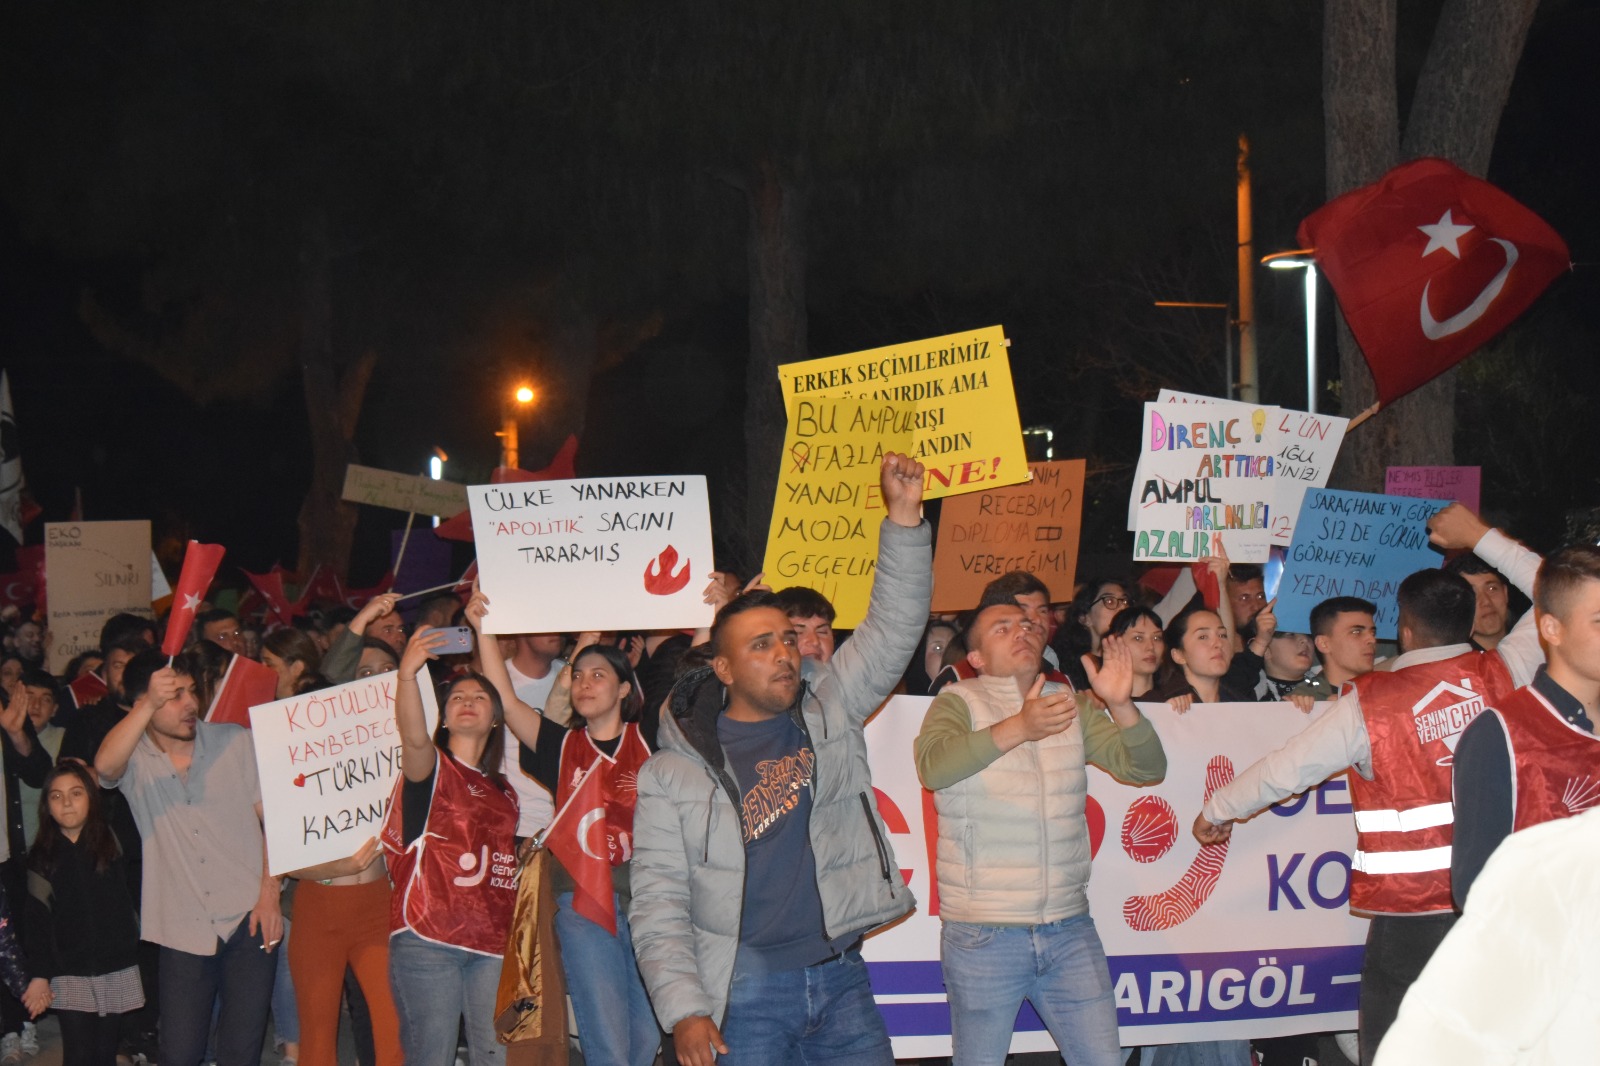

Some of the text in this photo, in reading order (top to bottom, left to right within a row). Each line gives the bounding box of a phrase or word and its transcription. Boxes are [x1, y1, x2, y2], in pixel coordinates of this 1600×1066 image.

[793, 338, 991, 394] ERKEK SEÇİMLERİMİZ
[948, 370, 990, 395] AMA
[796, 401, 914, 438] BU AMPUL
[812, 441, 884, 472] FAZLA
[1196, 454, 1274, 480] ARTTIKÇA
[484, 480, 686, 512] ÜLKE YANARKEN
[785, 481, 860, 507] YANDI
[1140, 478, 1222, 504] AMPUL
[777, 515, 866, 542] MODA
[1185, 501, 1270, 530] PARLAKLIĞI
[1317, 516, 1346, 541] SİZ
[1350, 522, 1373, 542] DE
[517, 542, 621, 566] TARARMIŞ
[284, 681, 396, 733] KÖTÜLÜK
[1414, 707, 1448, 732] SENİN
[288, 717, 401, 766] KAYBEDEC
[1417, 721, 1450, 745] YERİN
[492, 852, 514, 863] CHP
